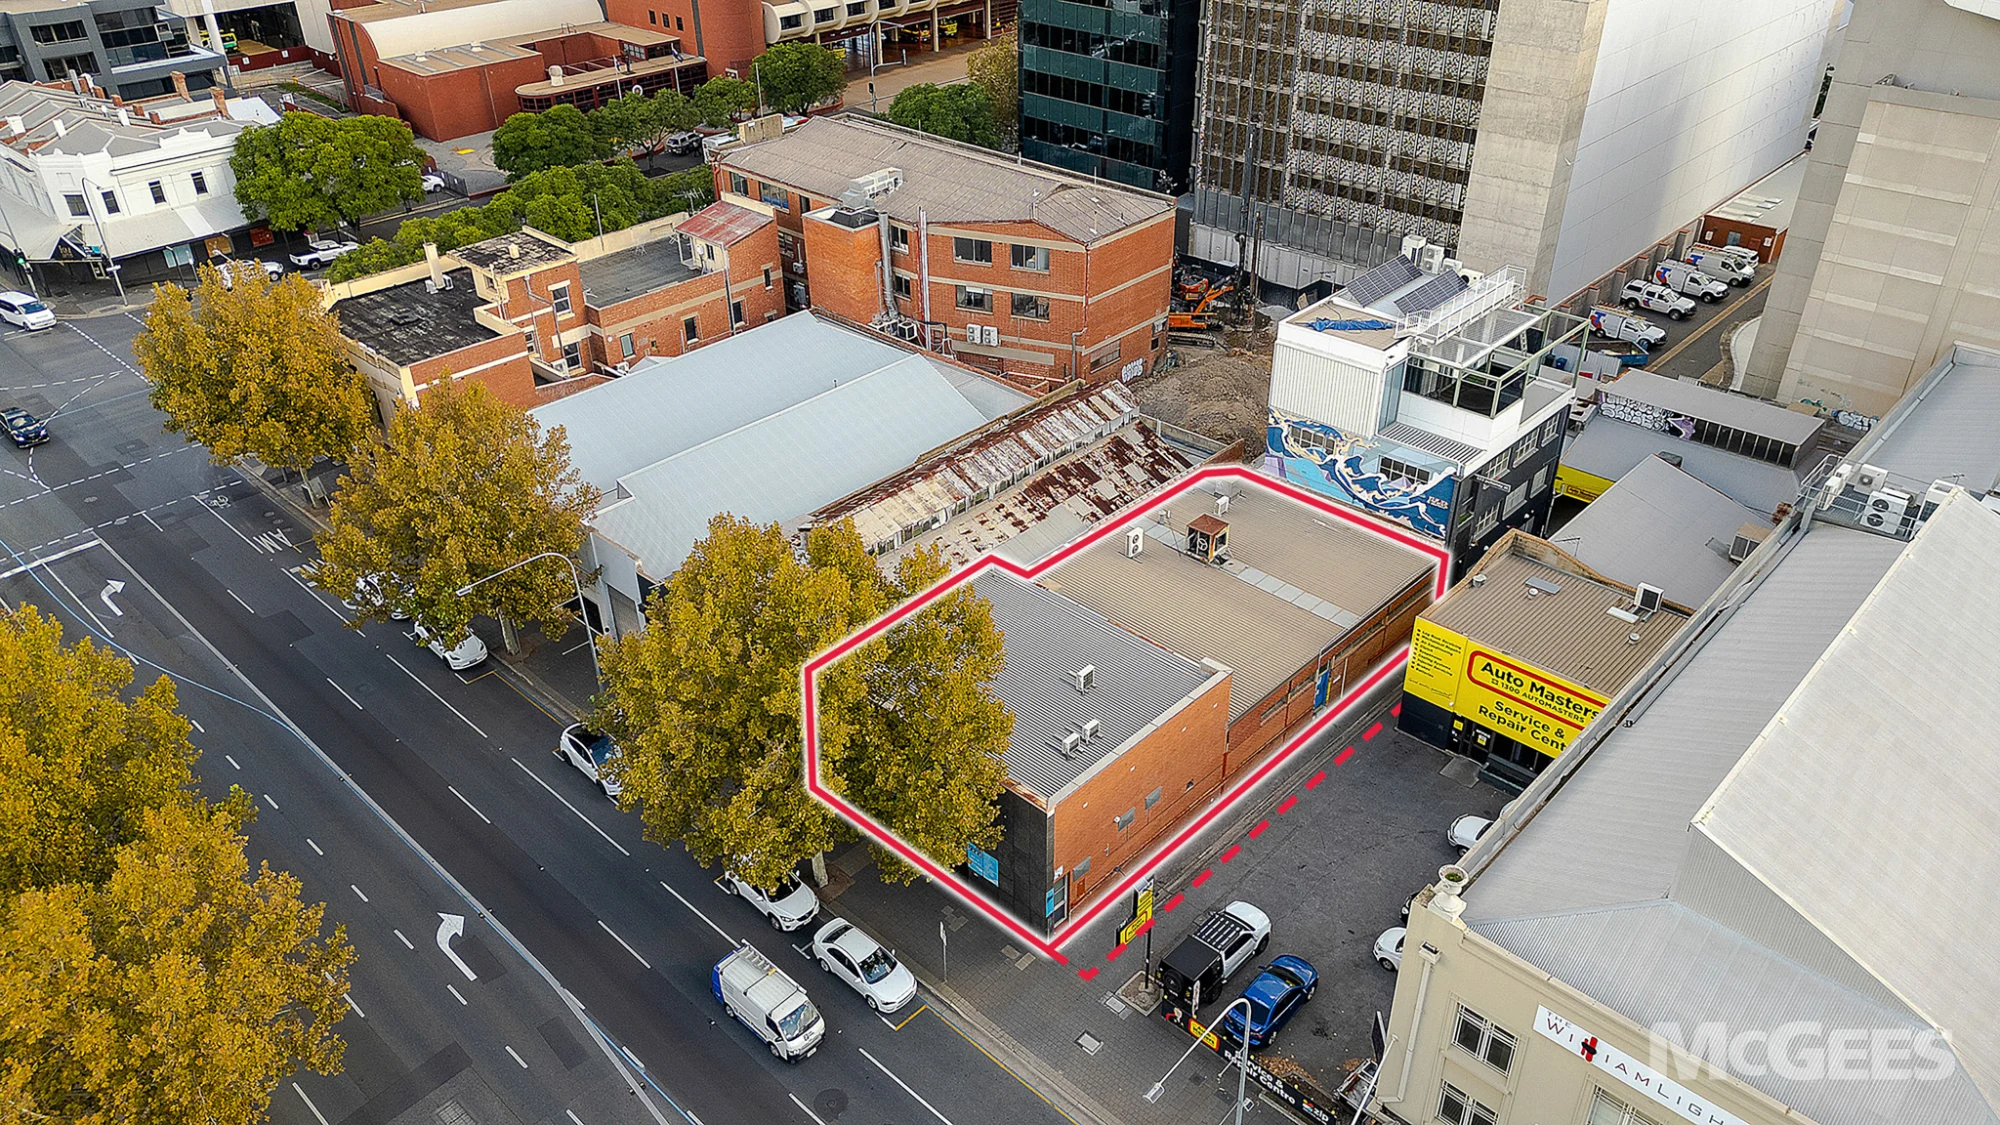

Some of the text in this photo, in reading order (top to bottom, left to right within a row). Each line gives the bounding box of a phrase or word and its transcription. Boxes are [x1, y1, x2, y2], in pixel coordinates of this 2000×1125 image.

[1481, 662, 1600, 720] Auto Masters
[1501, 682, 1585, 724] 1300 AUTOMASTERS
[1478, 705, 1527, 733] Repair
[1494, 700, 1565, 739] Service &
[1546, 1010, 1572, 1029] THE
[1260, 1075, 1296, 1105] Centre
[1276, 1080, 1284, 1089] &
